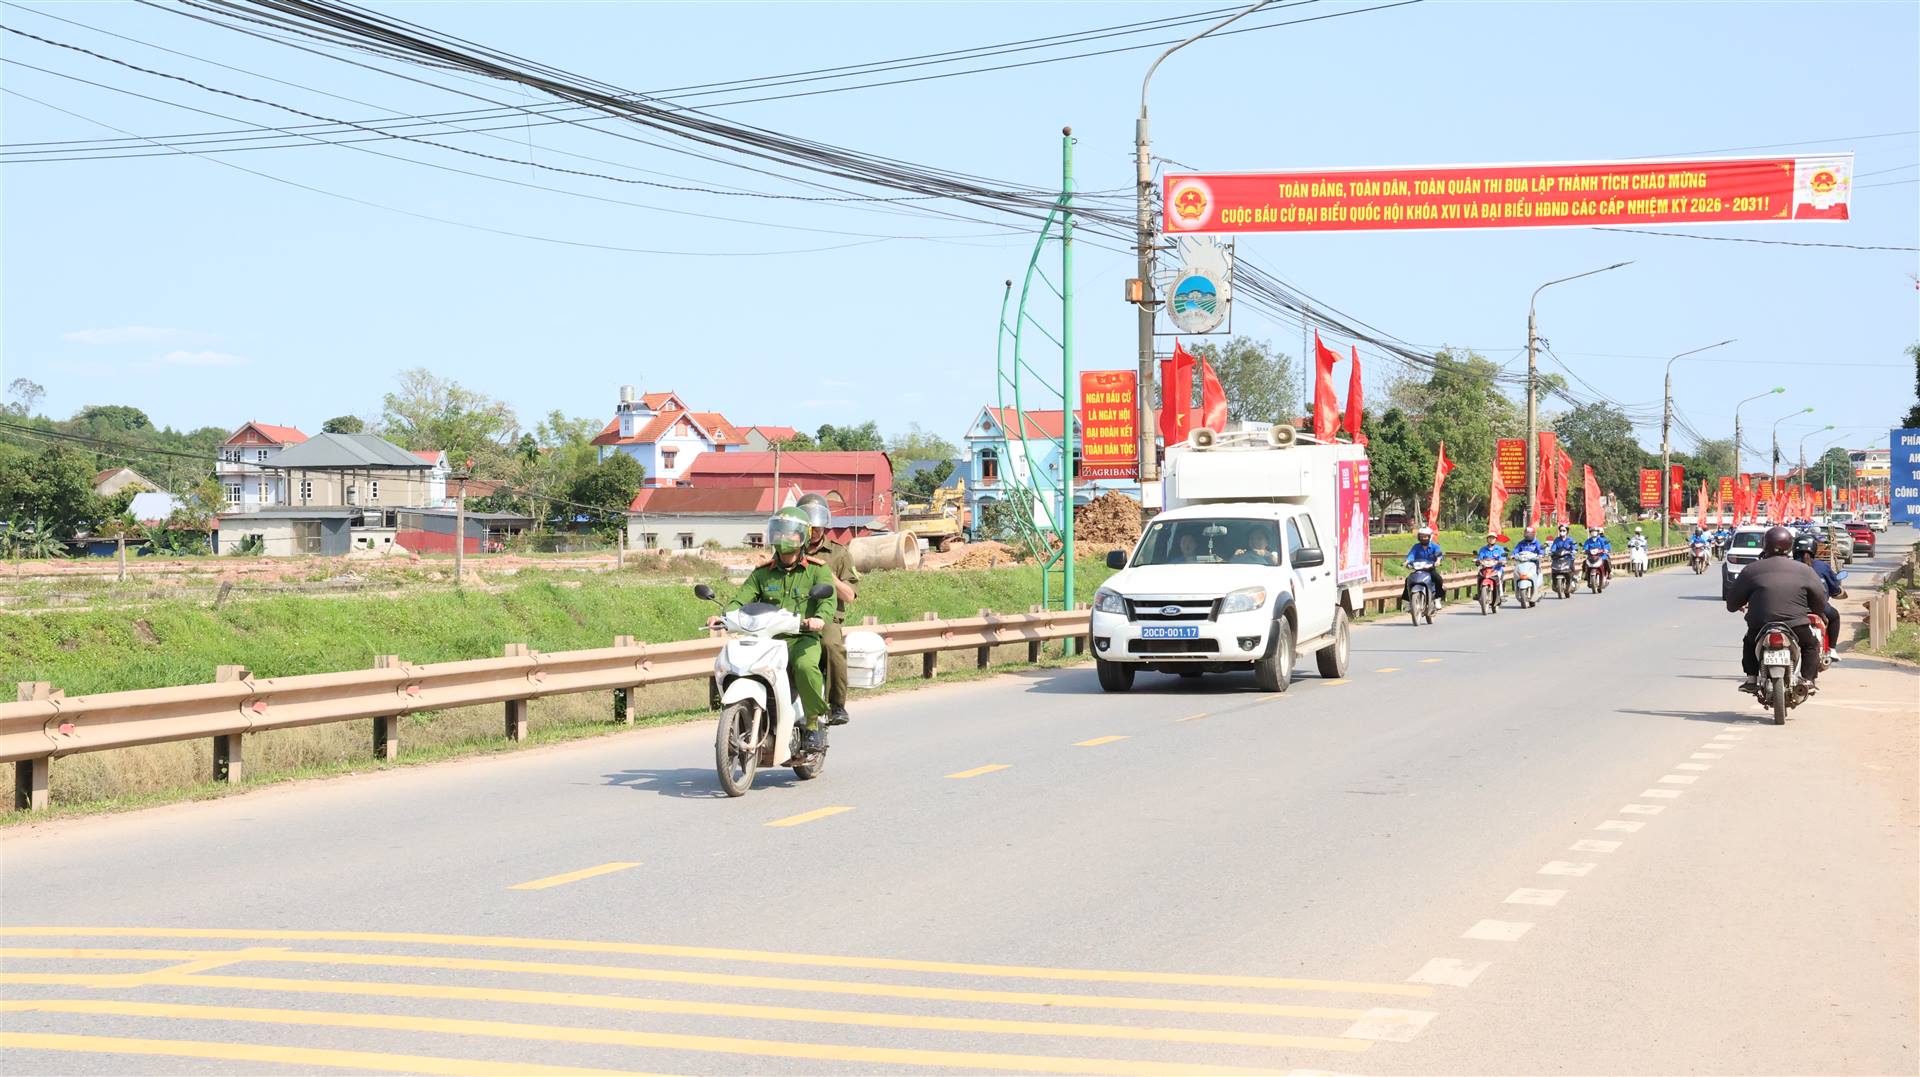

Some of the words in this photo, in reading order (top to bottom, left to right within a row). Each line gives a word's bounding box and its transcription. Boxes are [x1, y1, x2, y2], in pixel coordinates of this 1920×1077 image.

[1279, 181, 1309, 198] TOÀN
[1311, 179, 1347, 199] ĐẢNG,
[1349, 179, 1380, 197] TOÀN
[1383, 178, 1411, 197] DÂN,
[1414, 177, 1445, 195] TOÀN
[1448, 177, 1481, 196] QUÂN
[1484, 179, 1502, 193] THI
[1505, 178, 1528, 193] ĐUA
[1531, 175, 1555, 195] LẬP
[1558, 174, 1599, 191] THÀNH
[1601, 173, 1629, 190] TÍCH
[1632, 172, 1665, 190] CHÀO
[1668, 171, 1707, 189] MỪNG
[1222, 206, 1252, 226] CUỘC
[1255, 204, 1277, 223] BẦU
[1280, 203, 1297, 222] CỬ
[1298, 207, 1318, 225] ĐẠI
[1320, 202, 1347, 221] BIỂU
[1350, 201, 1381, 222] QUỐC
[1384, 203, 1403, 223] HỘI
[1406, 202, 1438, 220] KHÓA
[1441, 204, 1460, 219] XVI
[1463, 201, 1479, 218] VÀ
[1481, 203, 1501, 221] ĐẠI
[1504, 197, 1532, 217] BIỂU
[1535, 202, 1569, 217] HĐND
[1571, 198, 1596, 216] CÁC
[1599, 195, 1625, 215] CẤP
[1628, 197, 1668, 217] NHIỆM
[1672, 196, 1688, 213] KỲ
[1690, 198, 1722, 213] 2026
[1732, 197, 1769, 212] 2031!
[1119, 408, 1130, 421] HỘI
[1120, 424, 1133, 437] KẾT
[1092, 468, 1138, 476] AGRIBANK
[1143, 628, 1197, 637] 20CD-001.17
